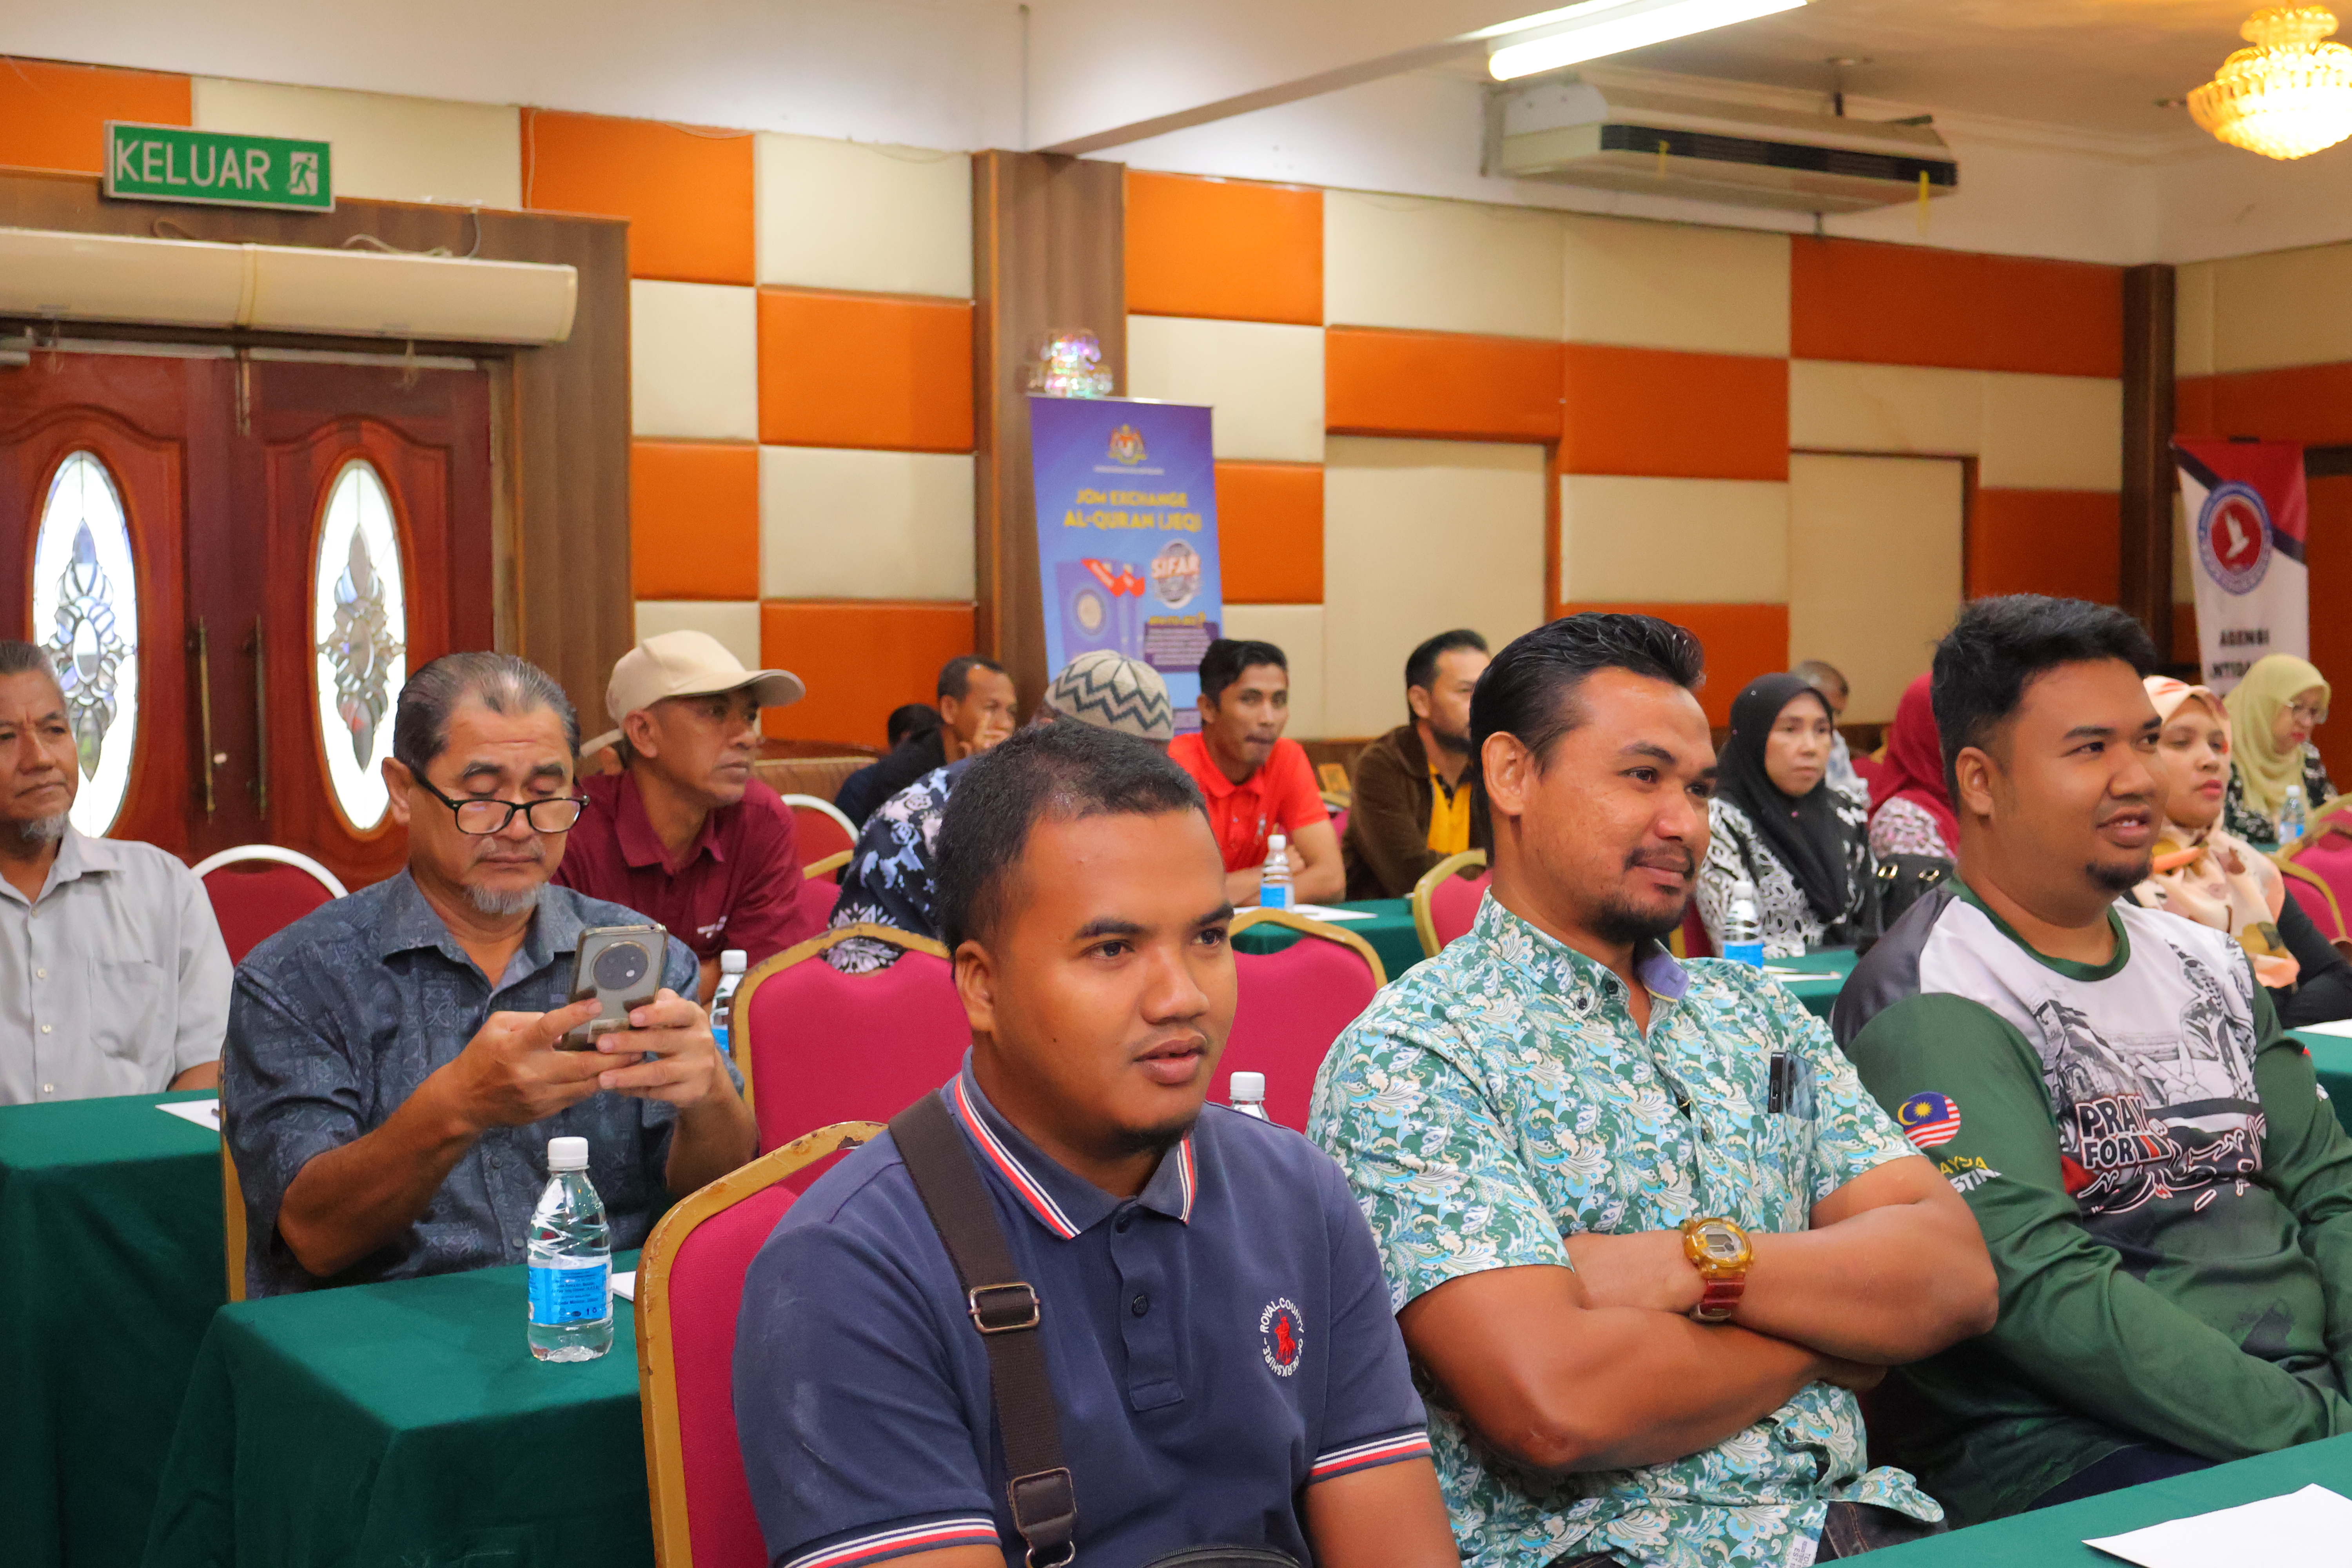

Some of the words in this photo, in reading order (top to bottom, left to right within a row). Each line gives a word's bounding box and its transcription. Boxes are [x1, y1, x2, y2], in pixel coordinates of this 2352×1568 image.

[117, 139, 270, 191] KELUAR
[1063, 510, 1154, 530] AL-QURAN
[2076, 1095, 2150, 1140] PRAY
[1260, 1301, 1280, 1333] ROYAL
[1279, 1297, 1304, 1333] COUNTY
[1298, 1338, 1303, 1356] OF
